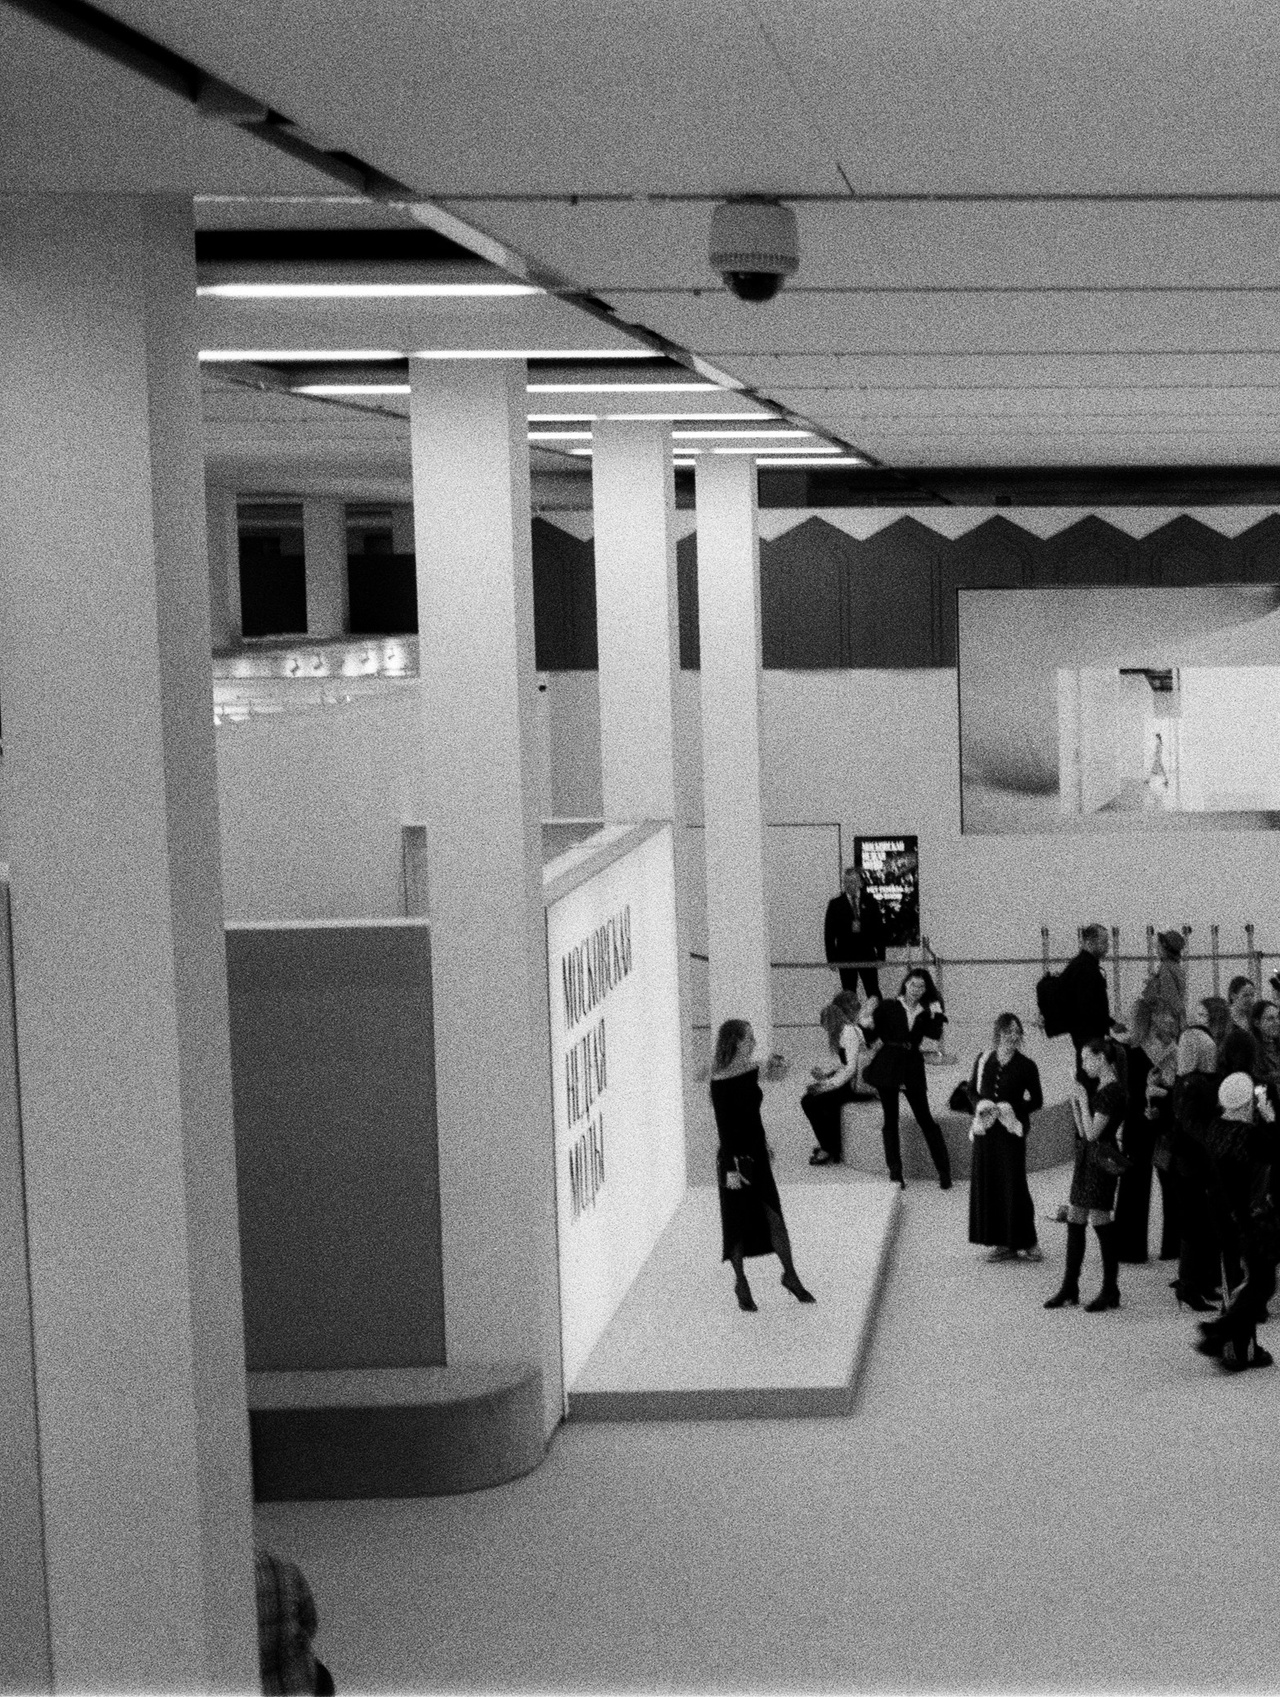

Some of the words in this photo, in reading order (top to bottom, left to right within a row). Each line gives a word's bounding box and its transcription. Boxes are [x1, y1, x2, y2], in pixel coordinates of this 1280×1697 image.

[562, 904, 632, 1029] МОСКОВСКАЯ
[565, 1018, 607, 1129] НЕДЕЛЯ
[569, 1111, 605, 1224] МОДЫ
